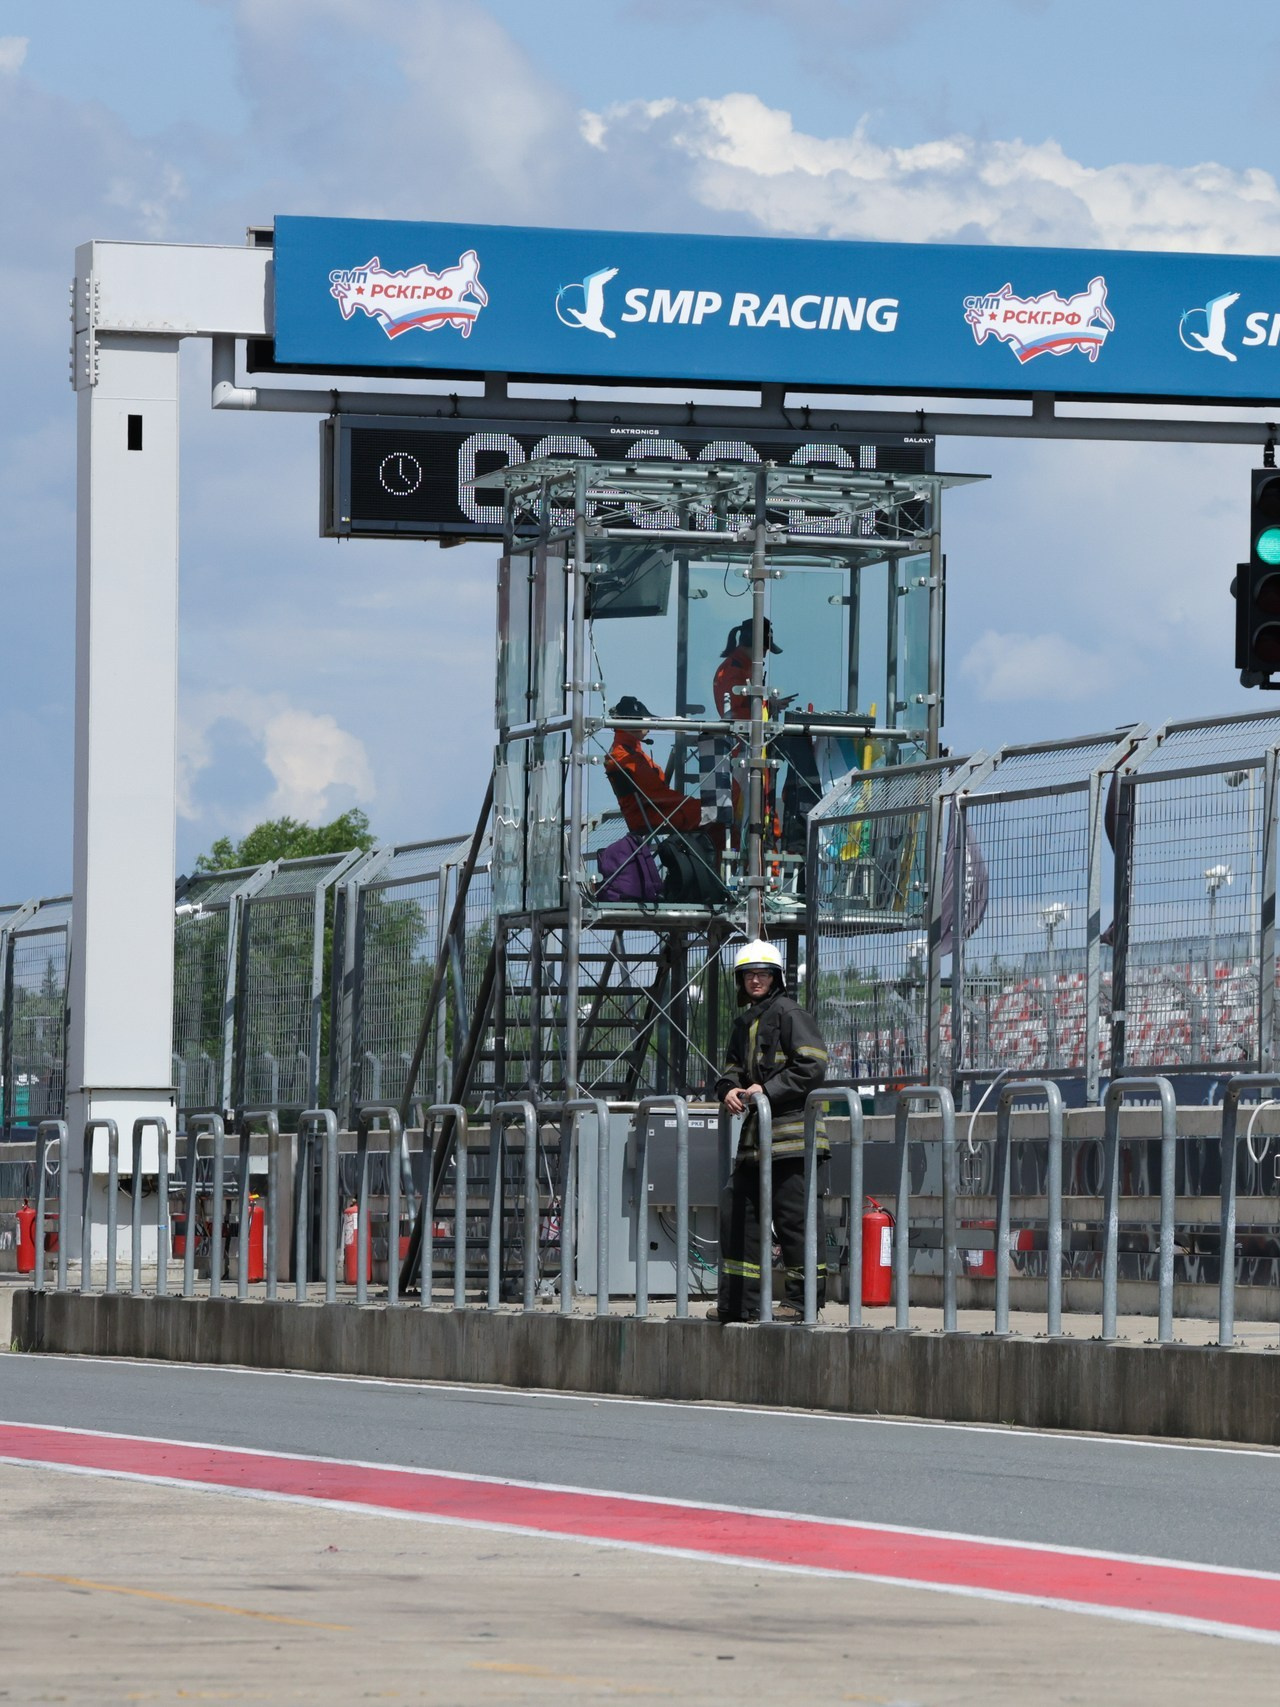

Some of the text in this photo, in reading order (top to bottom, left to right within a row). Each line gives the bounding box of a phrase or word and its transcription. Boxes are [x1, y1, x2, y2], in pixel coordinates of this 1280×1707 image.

[330, 270, 368, 284] СМП
[370, 284, 453, 300] РСКГ.РФ
[622, 288, 899, 332] SMP RACING
[964, 296, 1001, 310] СМП
[1002, 310, 1082, 325] РСКГ.РФ
